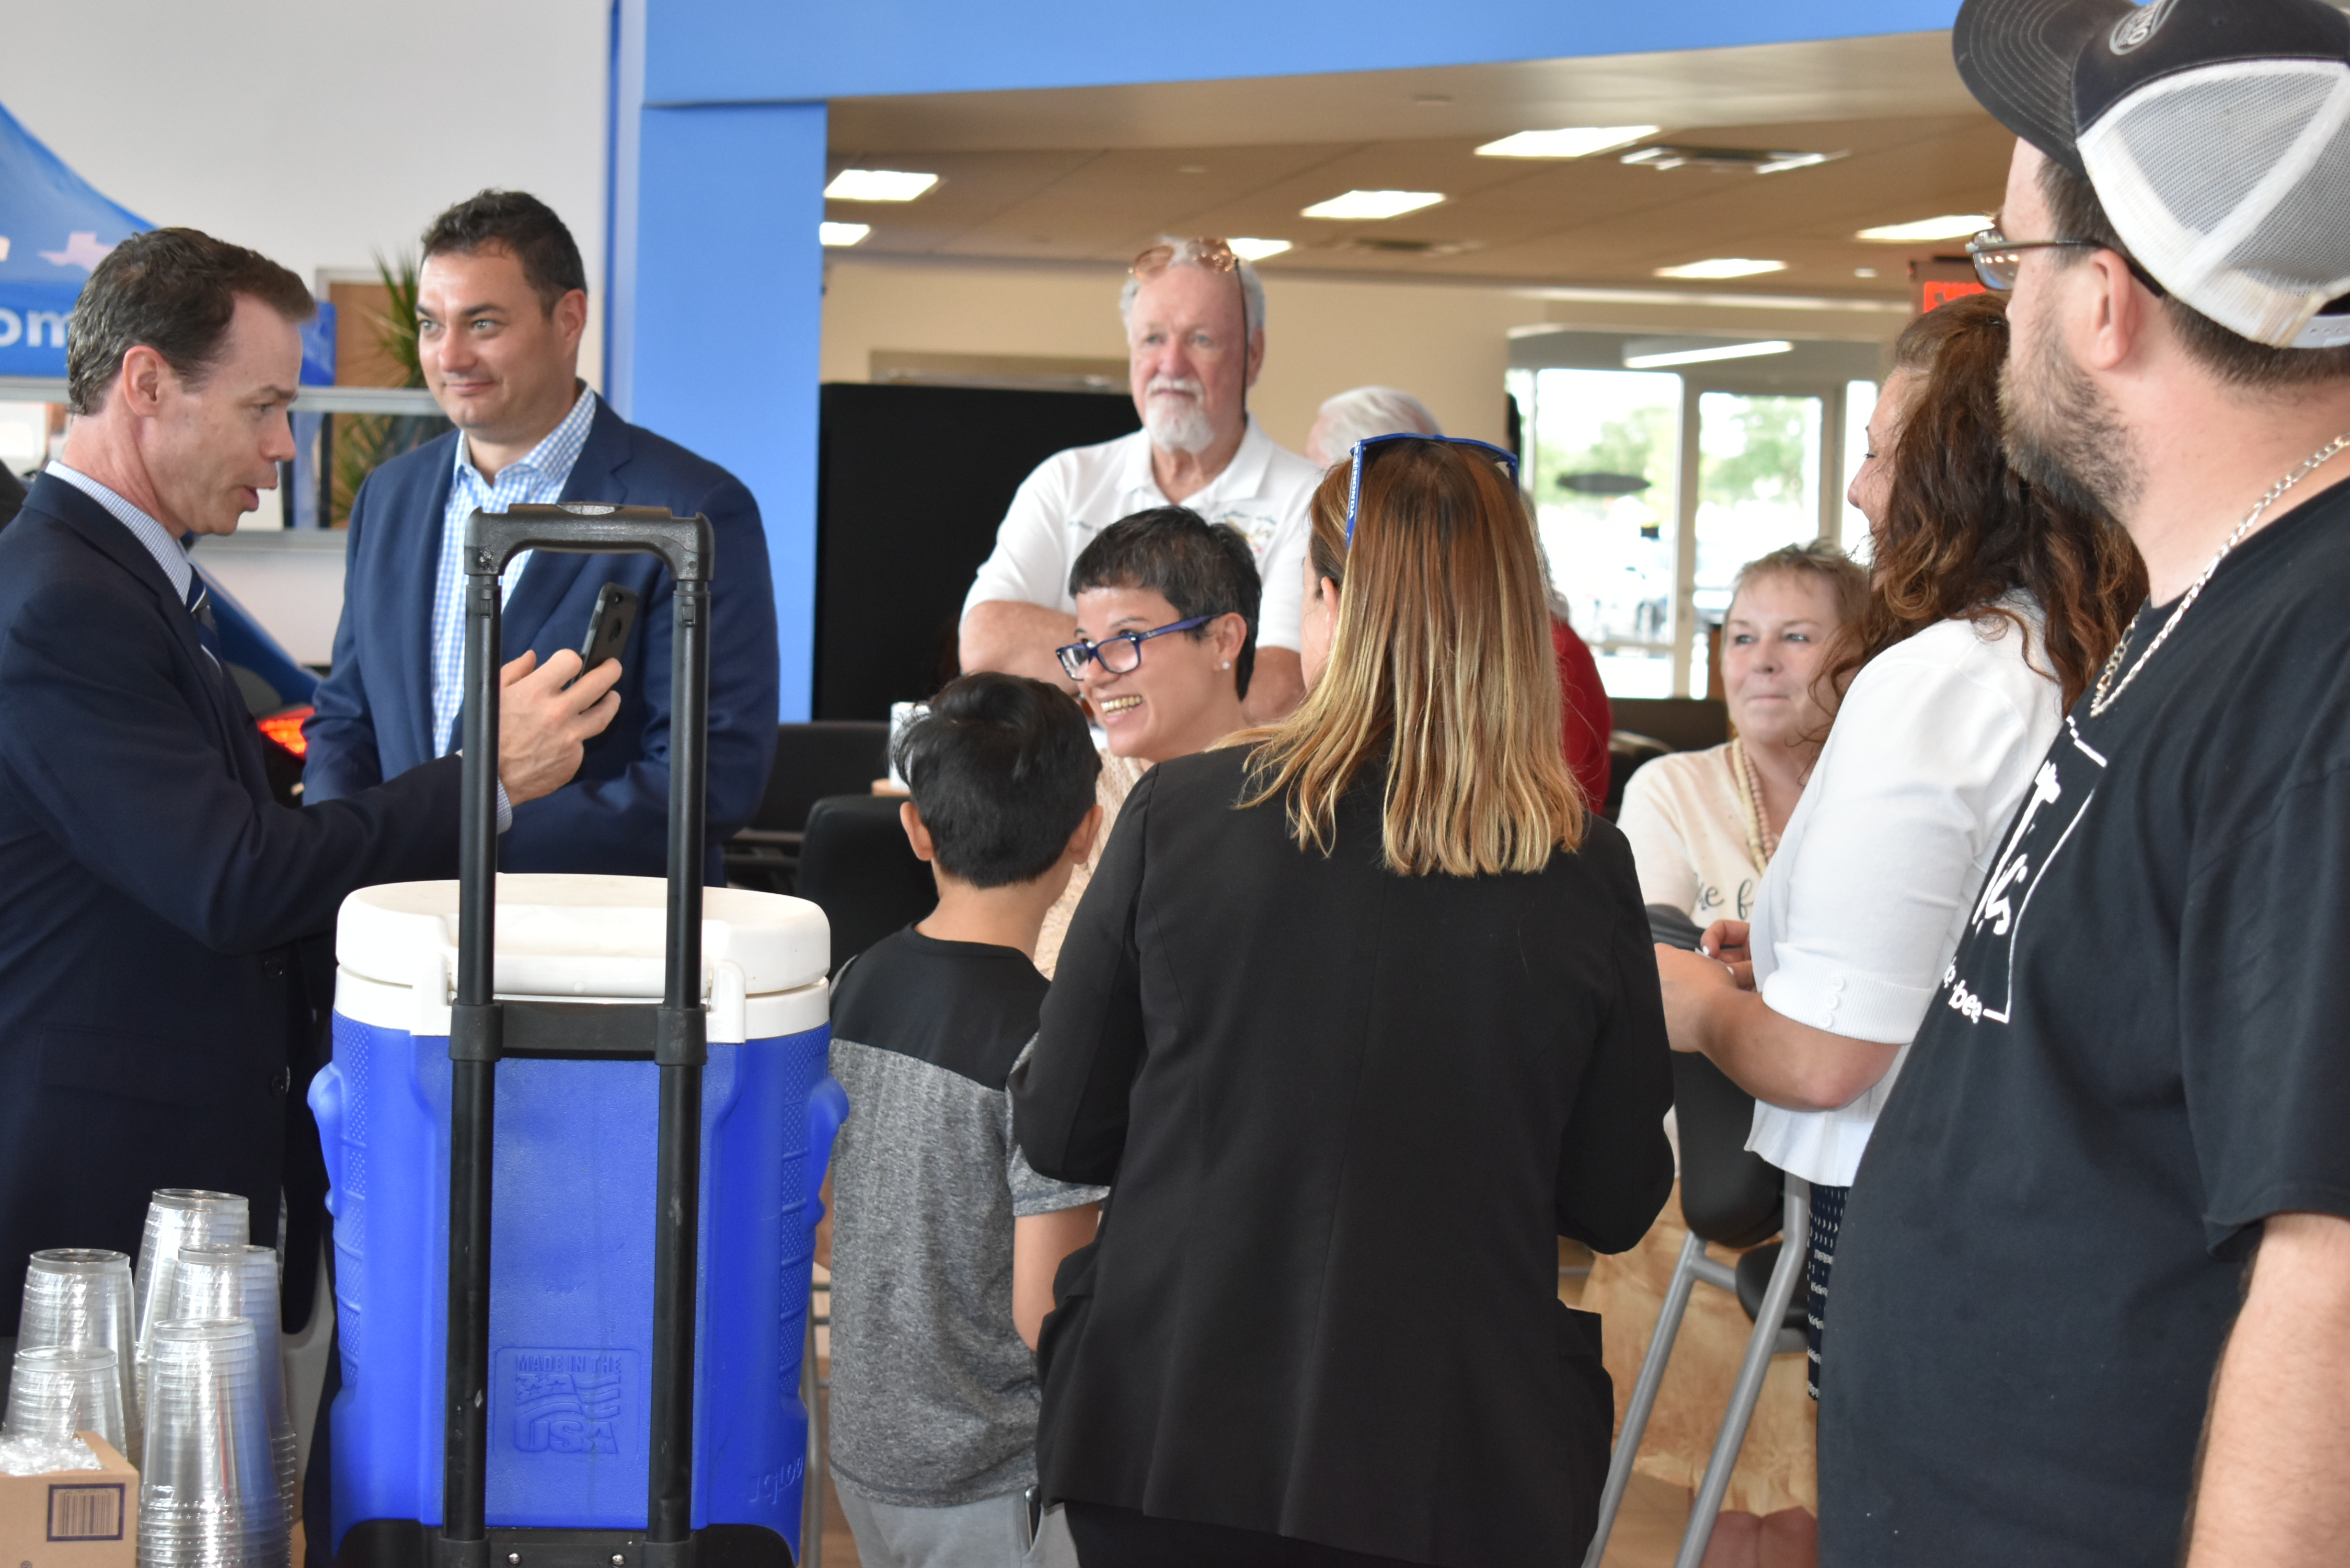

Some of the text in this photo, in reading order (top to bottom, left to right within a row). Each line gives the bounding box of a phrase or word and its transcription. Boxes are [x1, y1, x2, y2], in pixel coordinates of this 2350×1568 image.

[516, 1355, 621, 1374] MADE IN THE
[514, 1420, 618, 1454] USA
